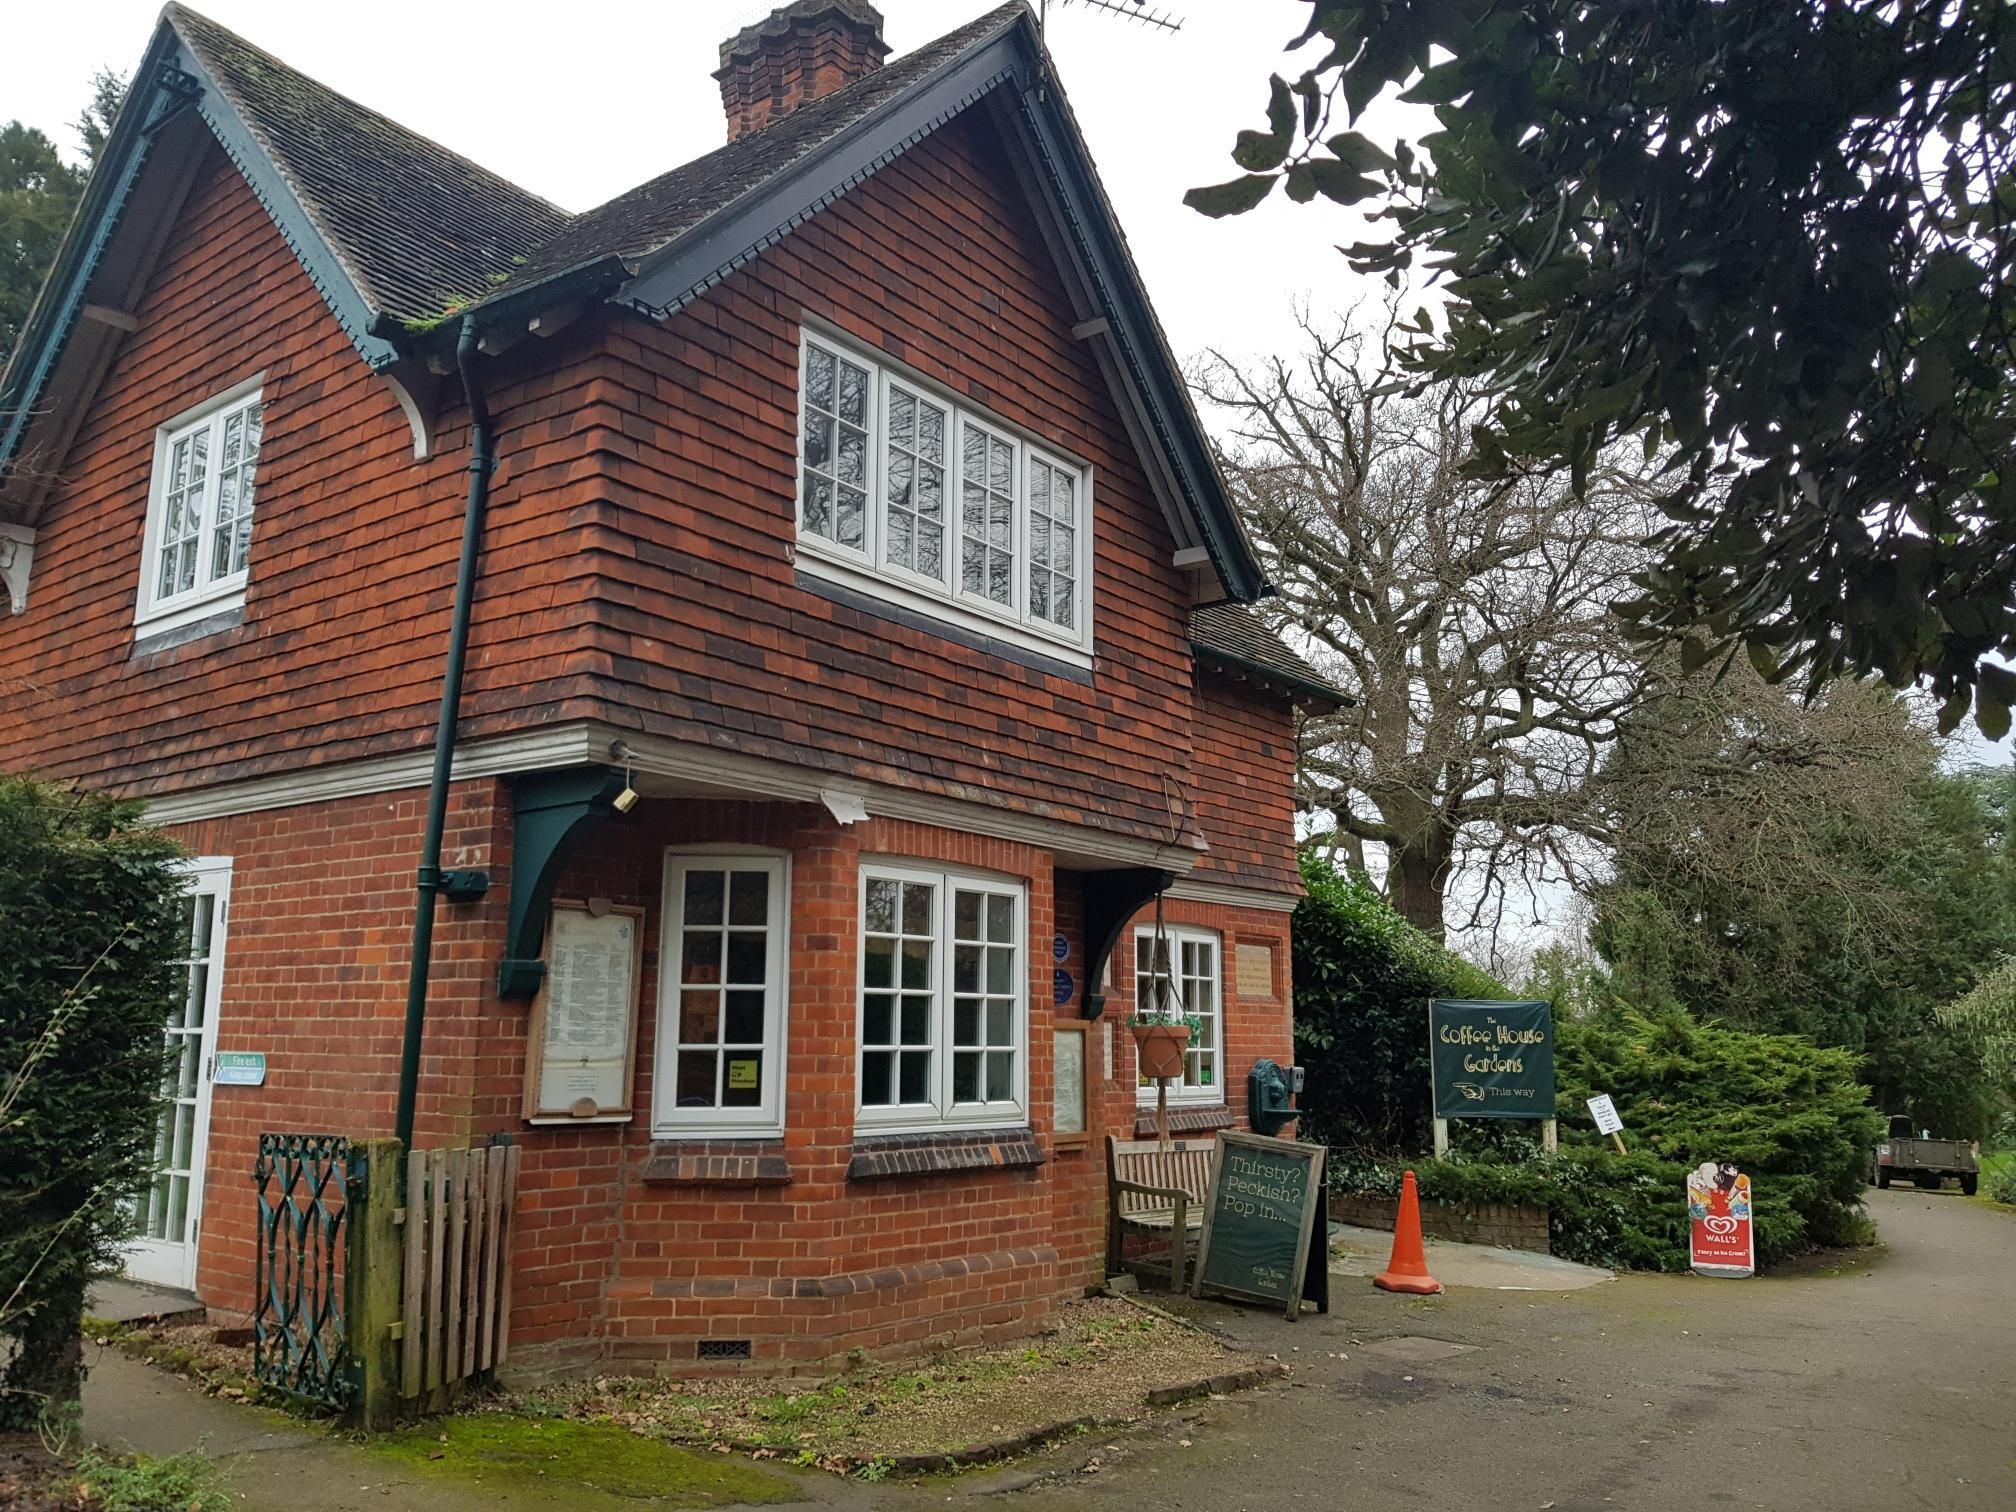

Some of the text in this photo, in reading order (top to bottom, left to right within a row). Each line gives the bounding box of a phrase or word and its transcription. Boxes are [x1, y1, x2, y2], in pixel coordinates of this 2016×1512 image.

[1440, 1024, 1544, 1045] Coffee House
[1463, 1053, 1523, 1073] Gardens
[1490, 1087, 1535, 1098] This way
[1231, 1156, 1301, 1184] Thirsty?
[1227, 1176, 1301, 1204] Peckish?
[1224, 1195, 1287, 1222] Pop in...
[1705, 1234, 1737, 1244] WALL'S
